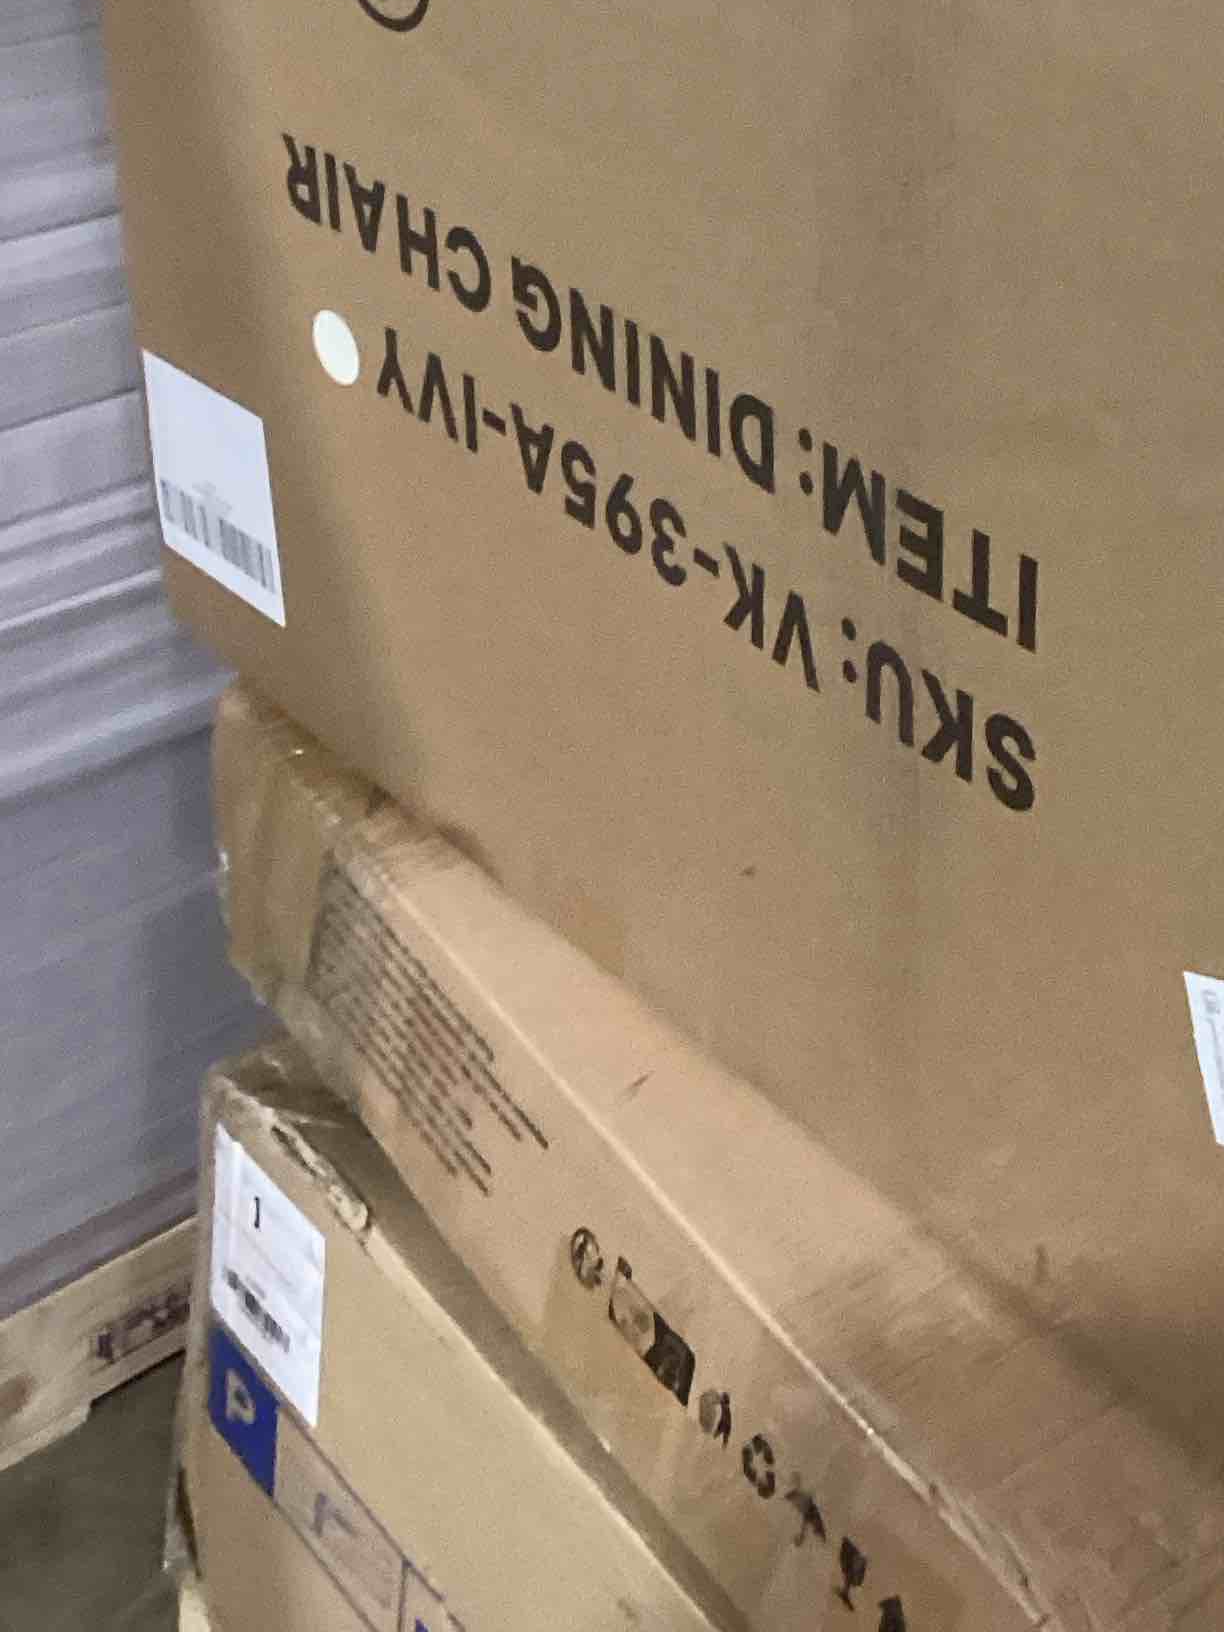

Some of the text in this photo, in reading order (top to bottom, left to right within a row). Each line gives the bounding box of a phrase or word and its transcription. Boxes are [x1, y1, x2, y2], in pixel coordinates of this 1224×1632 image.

[281, 131, 1040, 654] ITEM: DINING CHAIR
[375, 325, 1037, 813] SKU: VK-395A-IVY
